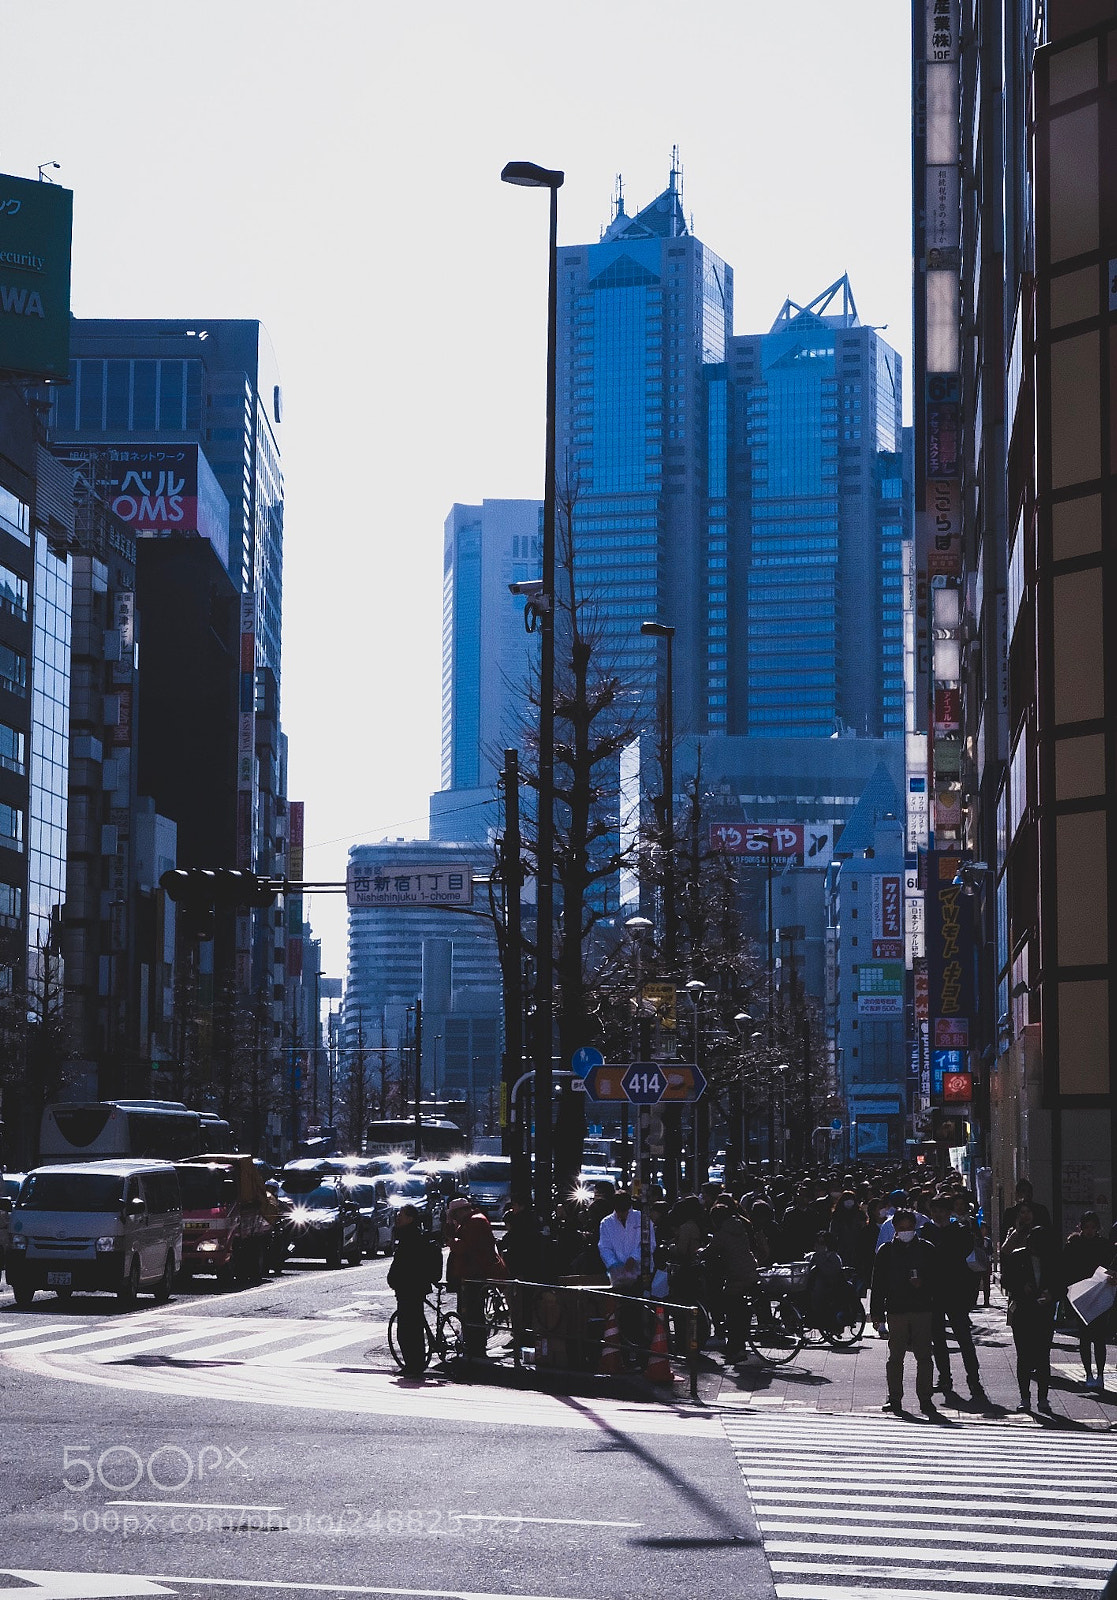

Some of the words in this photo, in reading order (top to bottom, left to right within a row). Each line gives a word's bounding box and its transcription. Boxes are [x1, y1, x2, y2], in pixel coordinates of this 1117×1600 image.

[933, 50, 950, 60] 10F
[717, 827, 798, 852] やまや
[354, 873, 464, 892] 西新宿1丁目
[885, 883, 899, 932] クリナップ
[938, 885, 962, 1015] マツモトキヨシ
[628, 1072, 661, 1094] 414
